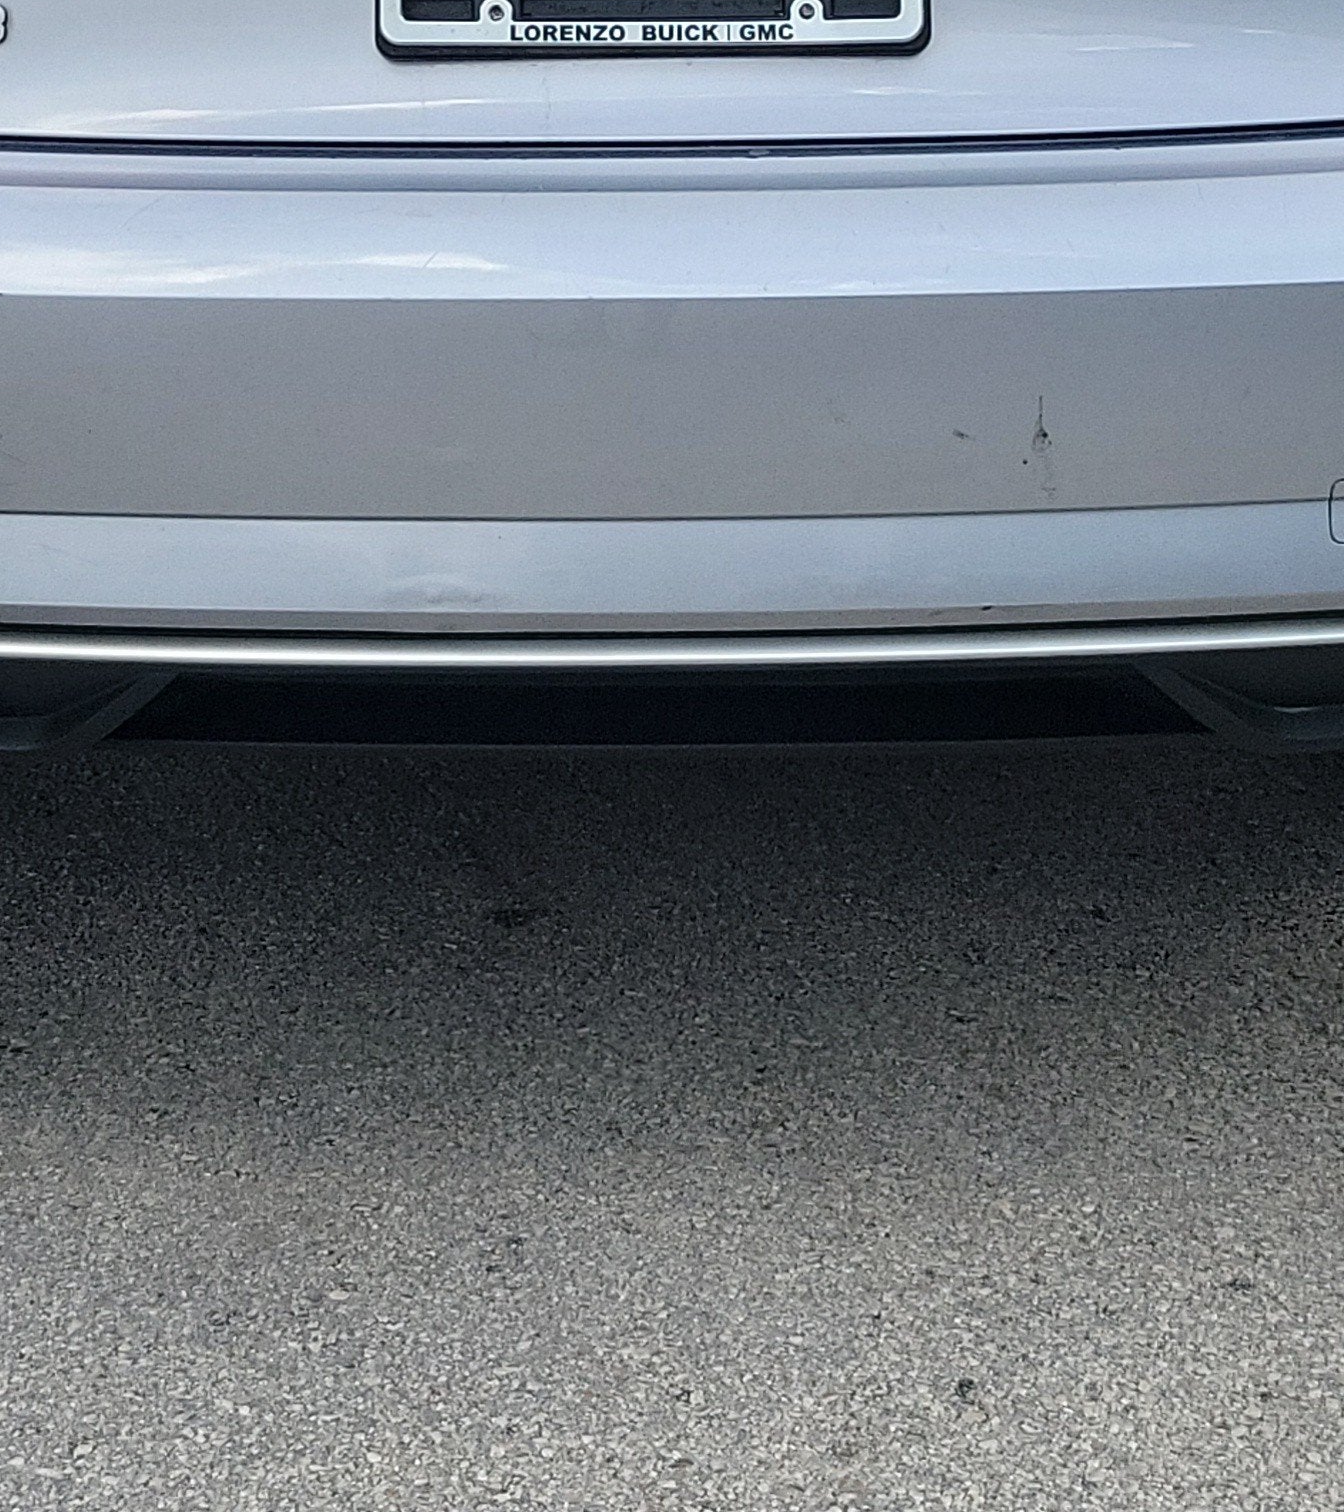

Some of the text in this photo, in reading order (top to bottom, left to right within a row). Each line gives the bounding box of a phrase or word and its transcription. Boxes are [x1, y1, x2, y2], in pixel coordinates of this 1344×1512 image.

[510, 23, 795, 41] LORENZO BUICK GMC
